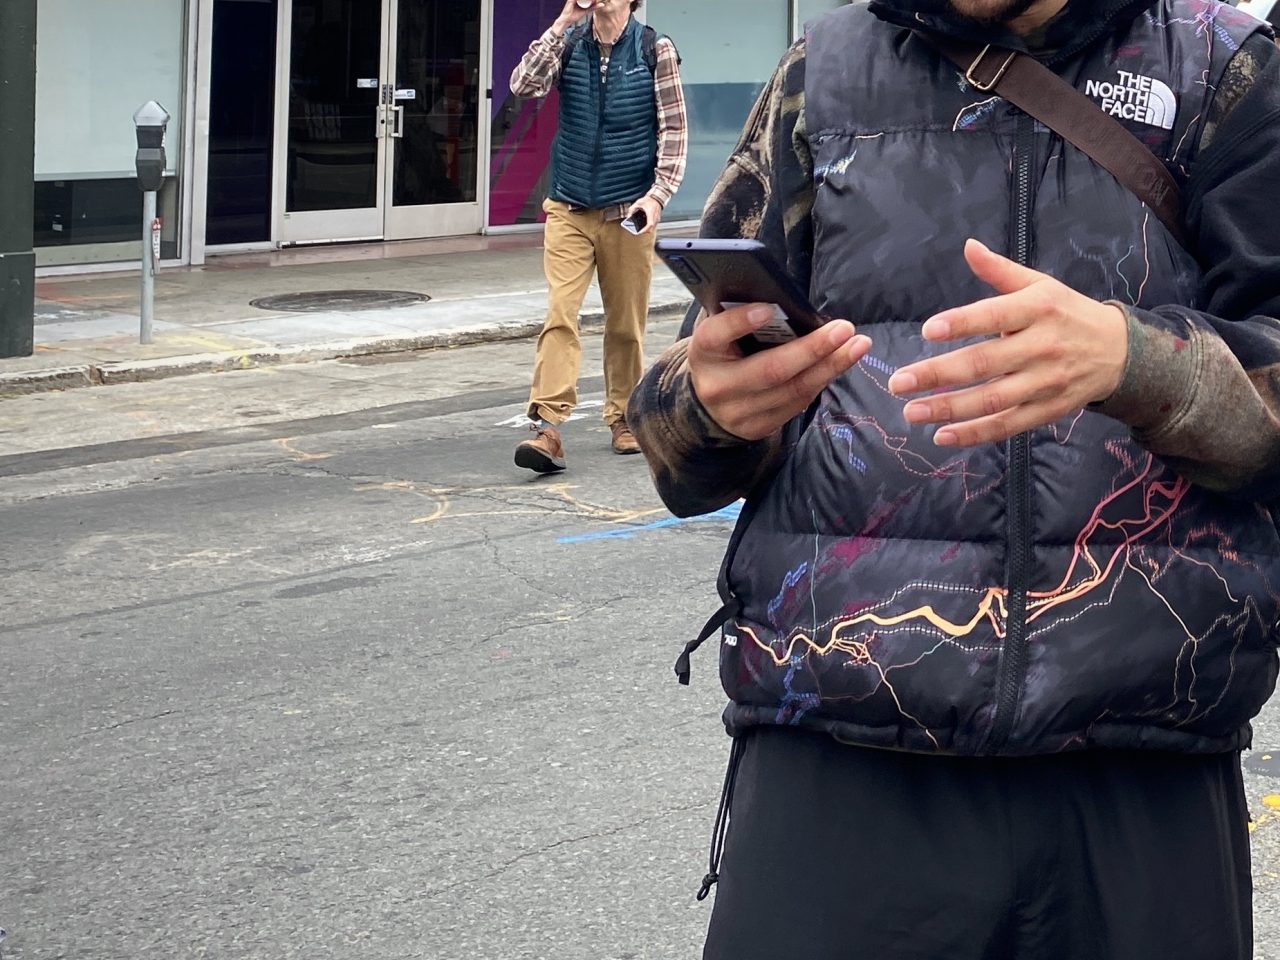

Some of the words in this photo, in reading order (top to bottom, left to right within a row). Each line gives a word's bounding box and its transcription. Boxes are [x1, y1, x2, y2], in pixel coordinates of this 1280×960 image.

[1085, 79, 1149, 107] NORTH
[1117, 70, 1152, 93] THE
[1101, 98, 1146, 123] FACE
